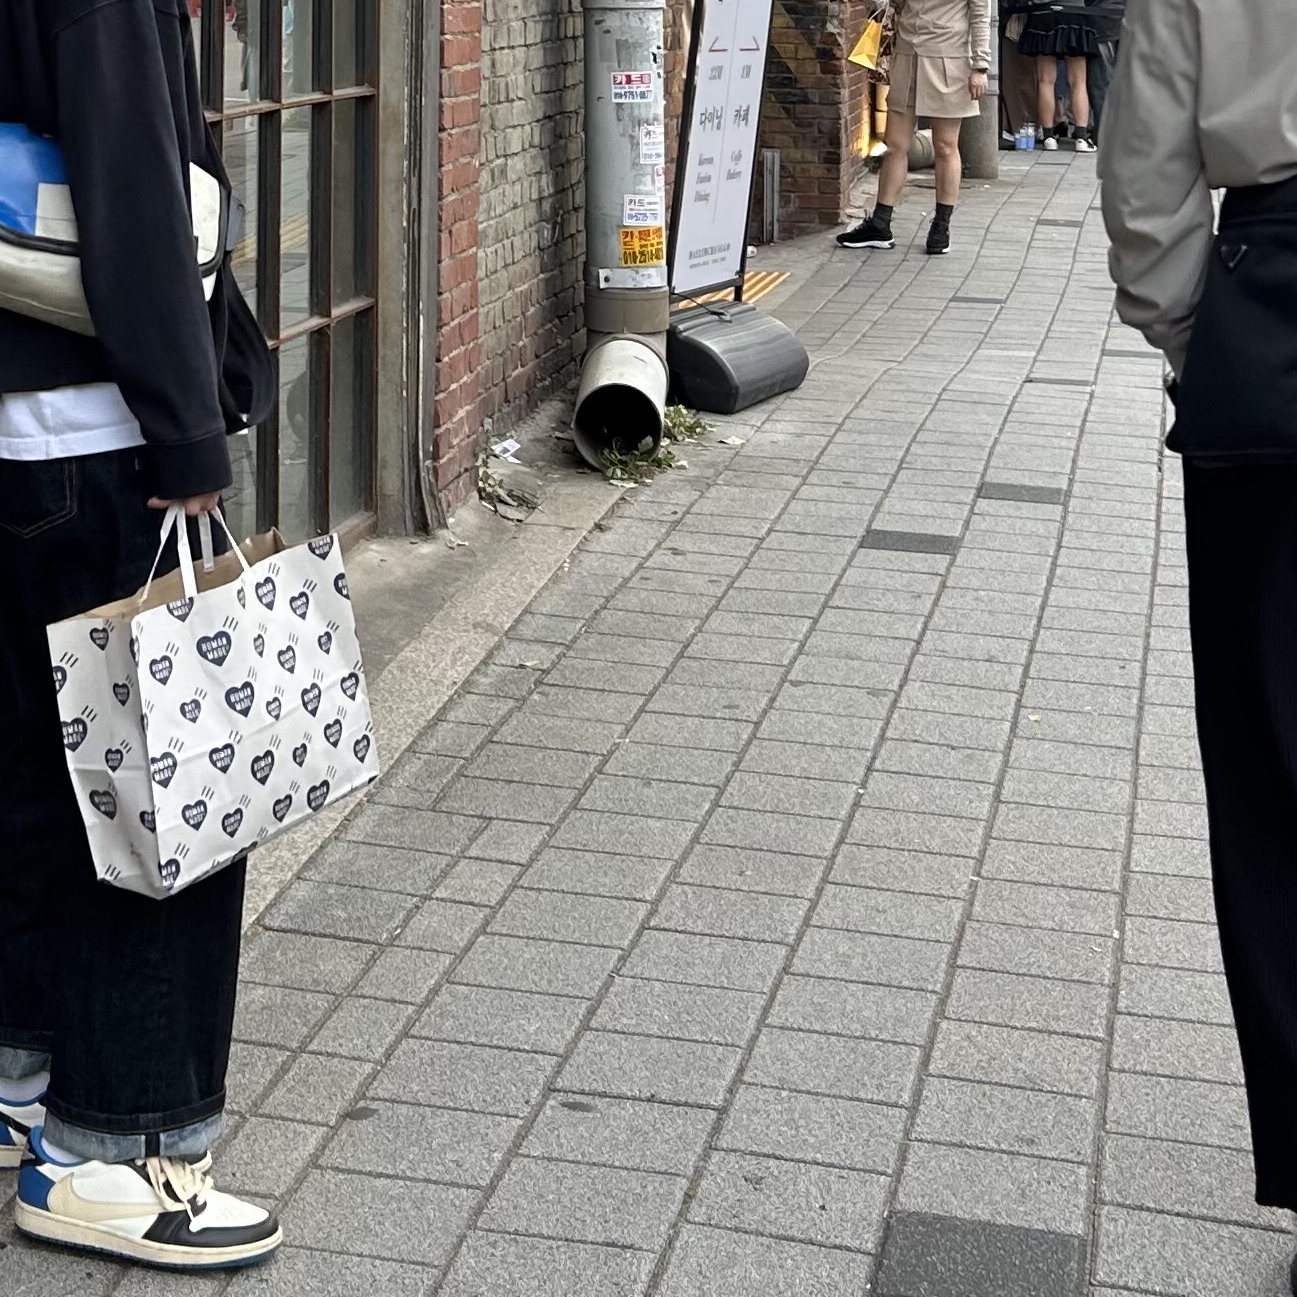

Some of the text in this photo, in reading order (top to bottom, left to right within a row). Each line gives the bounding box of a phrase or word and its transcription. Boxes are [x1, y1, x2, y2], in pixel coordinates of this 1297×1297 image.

[699, 105, 724, 133] 다이닝
[732, 104, 751, 129] 카페
[201, 636, 228, 652] HUMAN
[206, 645, 227, 660] MADE
